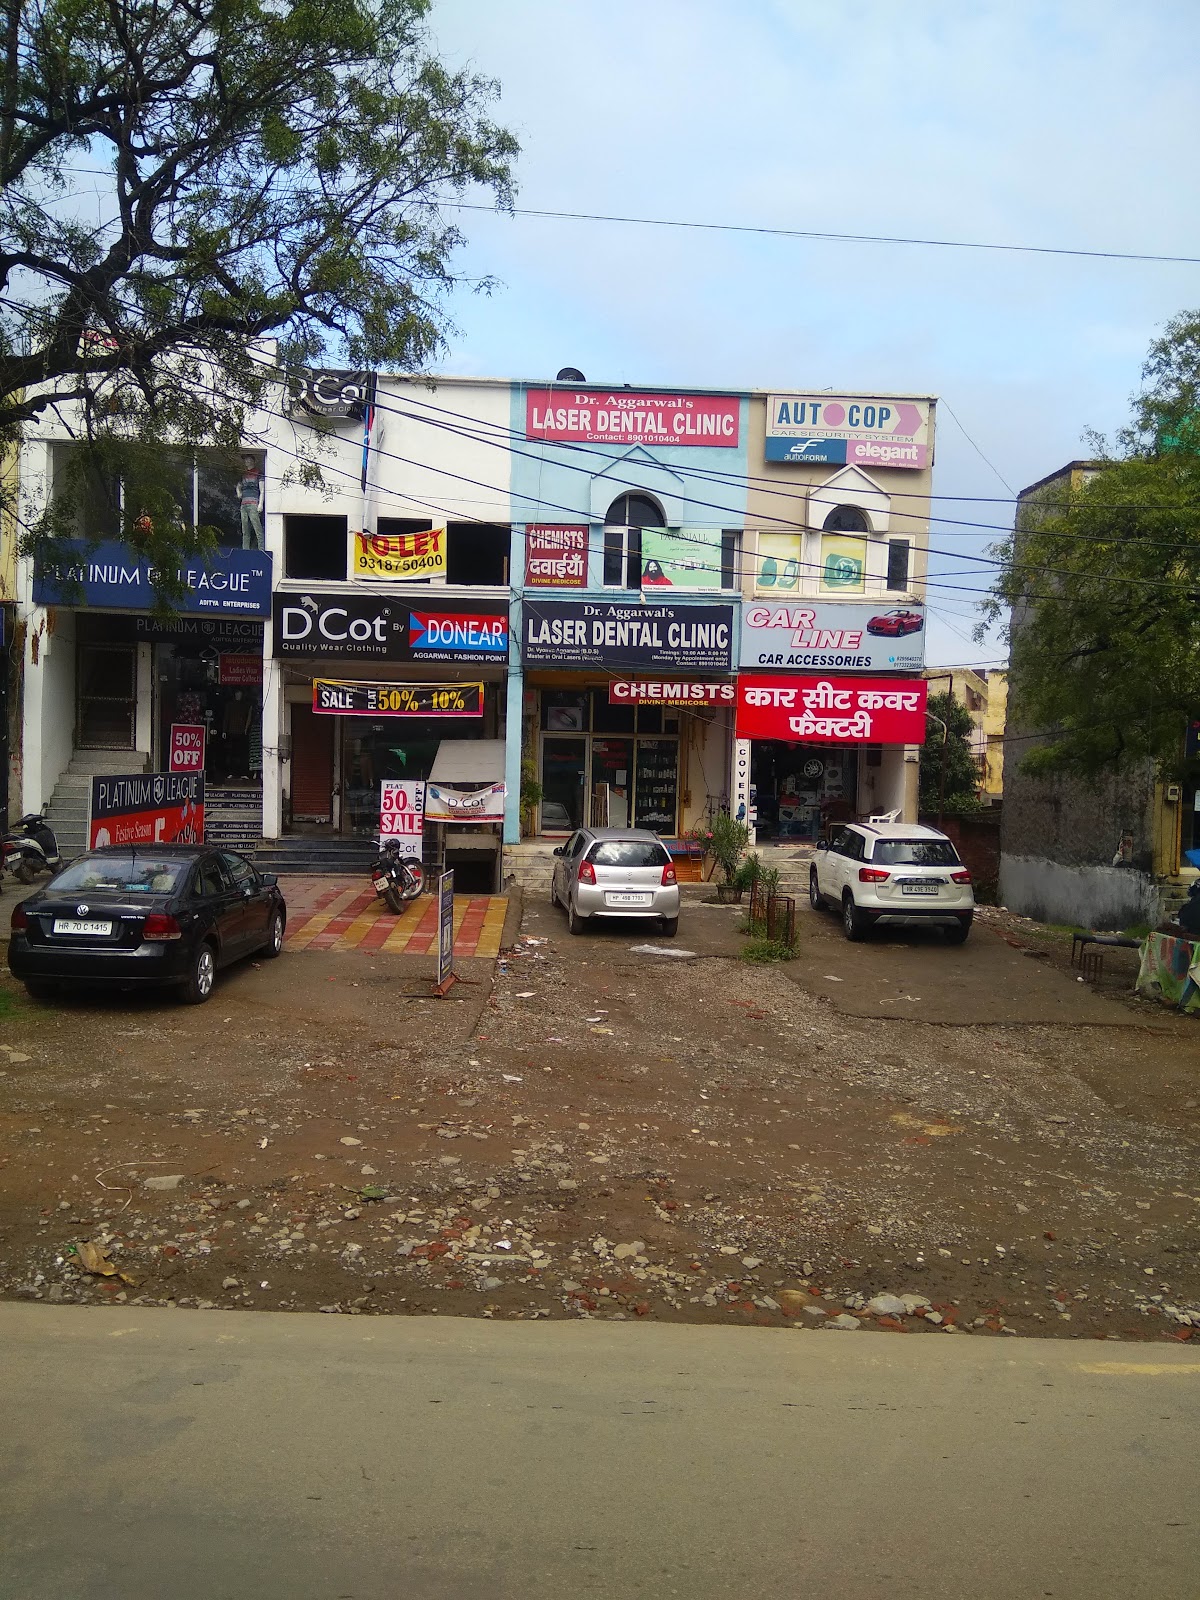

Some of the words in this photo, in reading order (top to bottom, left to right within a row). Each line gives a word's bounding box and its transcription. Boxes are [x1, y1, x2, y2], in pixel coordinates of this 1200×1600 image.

[574, 395, 600, 405] Dr.
[605, 396, 694, 410] Aggarwal's
[532, 407, 592, 431] LASER
[597, 410, 668, 434] DENTAL
[673, 413, 735, 436] CLINIC
[586, 432, 625, 441] Contact:
[627, 434, 680, 443] 8901010404
[804, 431, 861, 439] SECURITY
[865, 434, 914, 443] SYSTEM
[854, 441, 919, 461] elegant
[356, 530, 442, 557] TO-LET
[529, 529, 584, 550] CHEMISTS
[359, 554, 443, 571] 9318750400
[222, 601, 261, 609] ENTERPRISES
[583, 605, 603, 616] Dr.
[606, 606, 675, 621] Aggarwal's
[746, 608, 816, 629] CAR
[220, 623, 263, 636] LEAGUE
[392, 623, 405, 633] By
[427, 619, 504, 646] DONEAR
[528, 619, 587, 646] LASER
[592, 621, 663, 648] DENTAL
[667, 623, 729, 649] CLINIC
[282, 643, 318, 652] Quality
[346, 644, 387, 654] Clothing
[791, 630, 863, 649] LINE
[413, 652, 453, 660] AGGARWAL
[454, 653, 484, 661] FASHION
[758, 653, 784, 665] CAR
[786, 654, 872, 667] ACCESSORIES
[321, 691, 354, 709] SALE
[367, 689, 377, 710] FLAT
[378, 689, 419, 711] 50%
[431, 690, 465, 709] 10%
[613, 682, 735, 700] CHEMISTS
[744, 687, 798, 707] कार
[802, 681, 853, 709] सीट
[857, 690, 921, 711] कवर
[788, 709, 873, 738] फैक्टरी
[175, 732, 202, 748] 50%
[173, 749, 201, 766] OFF
[98, 780, 151, 810] PLATINUM
[166, 776, 198, 800] LEAGUE
[415, 787, 423, 812] OFF
[115, 822, 135, 843] Festive
[135, 821, 152, 839] Season
[381, 814, 423, 834] SALE
[83, 923, 89, 931] C
[91, 924, 108, 932] 1415
